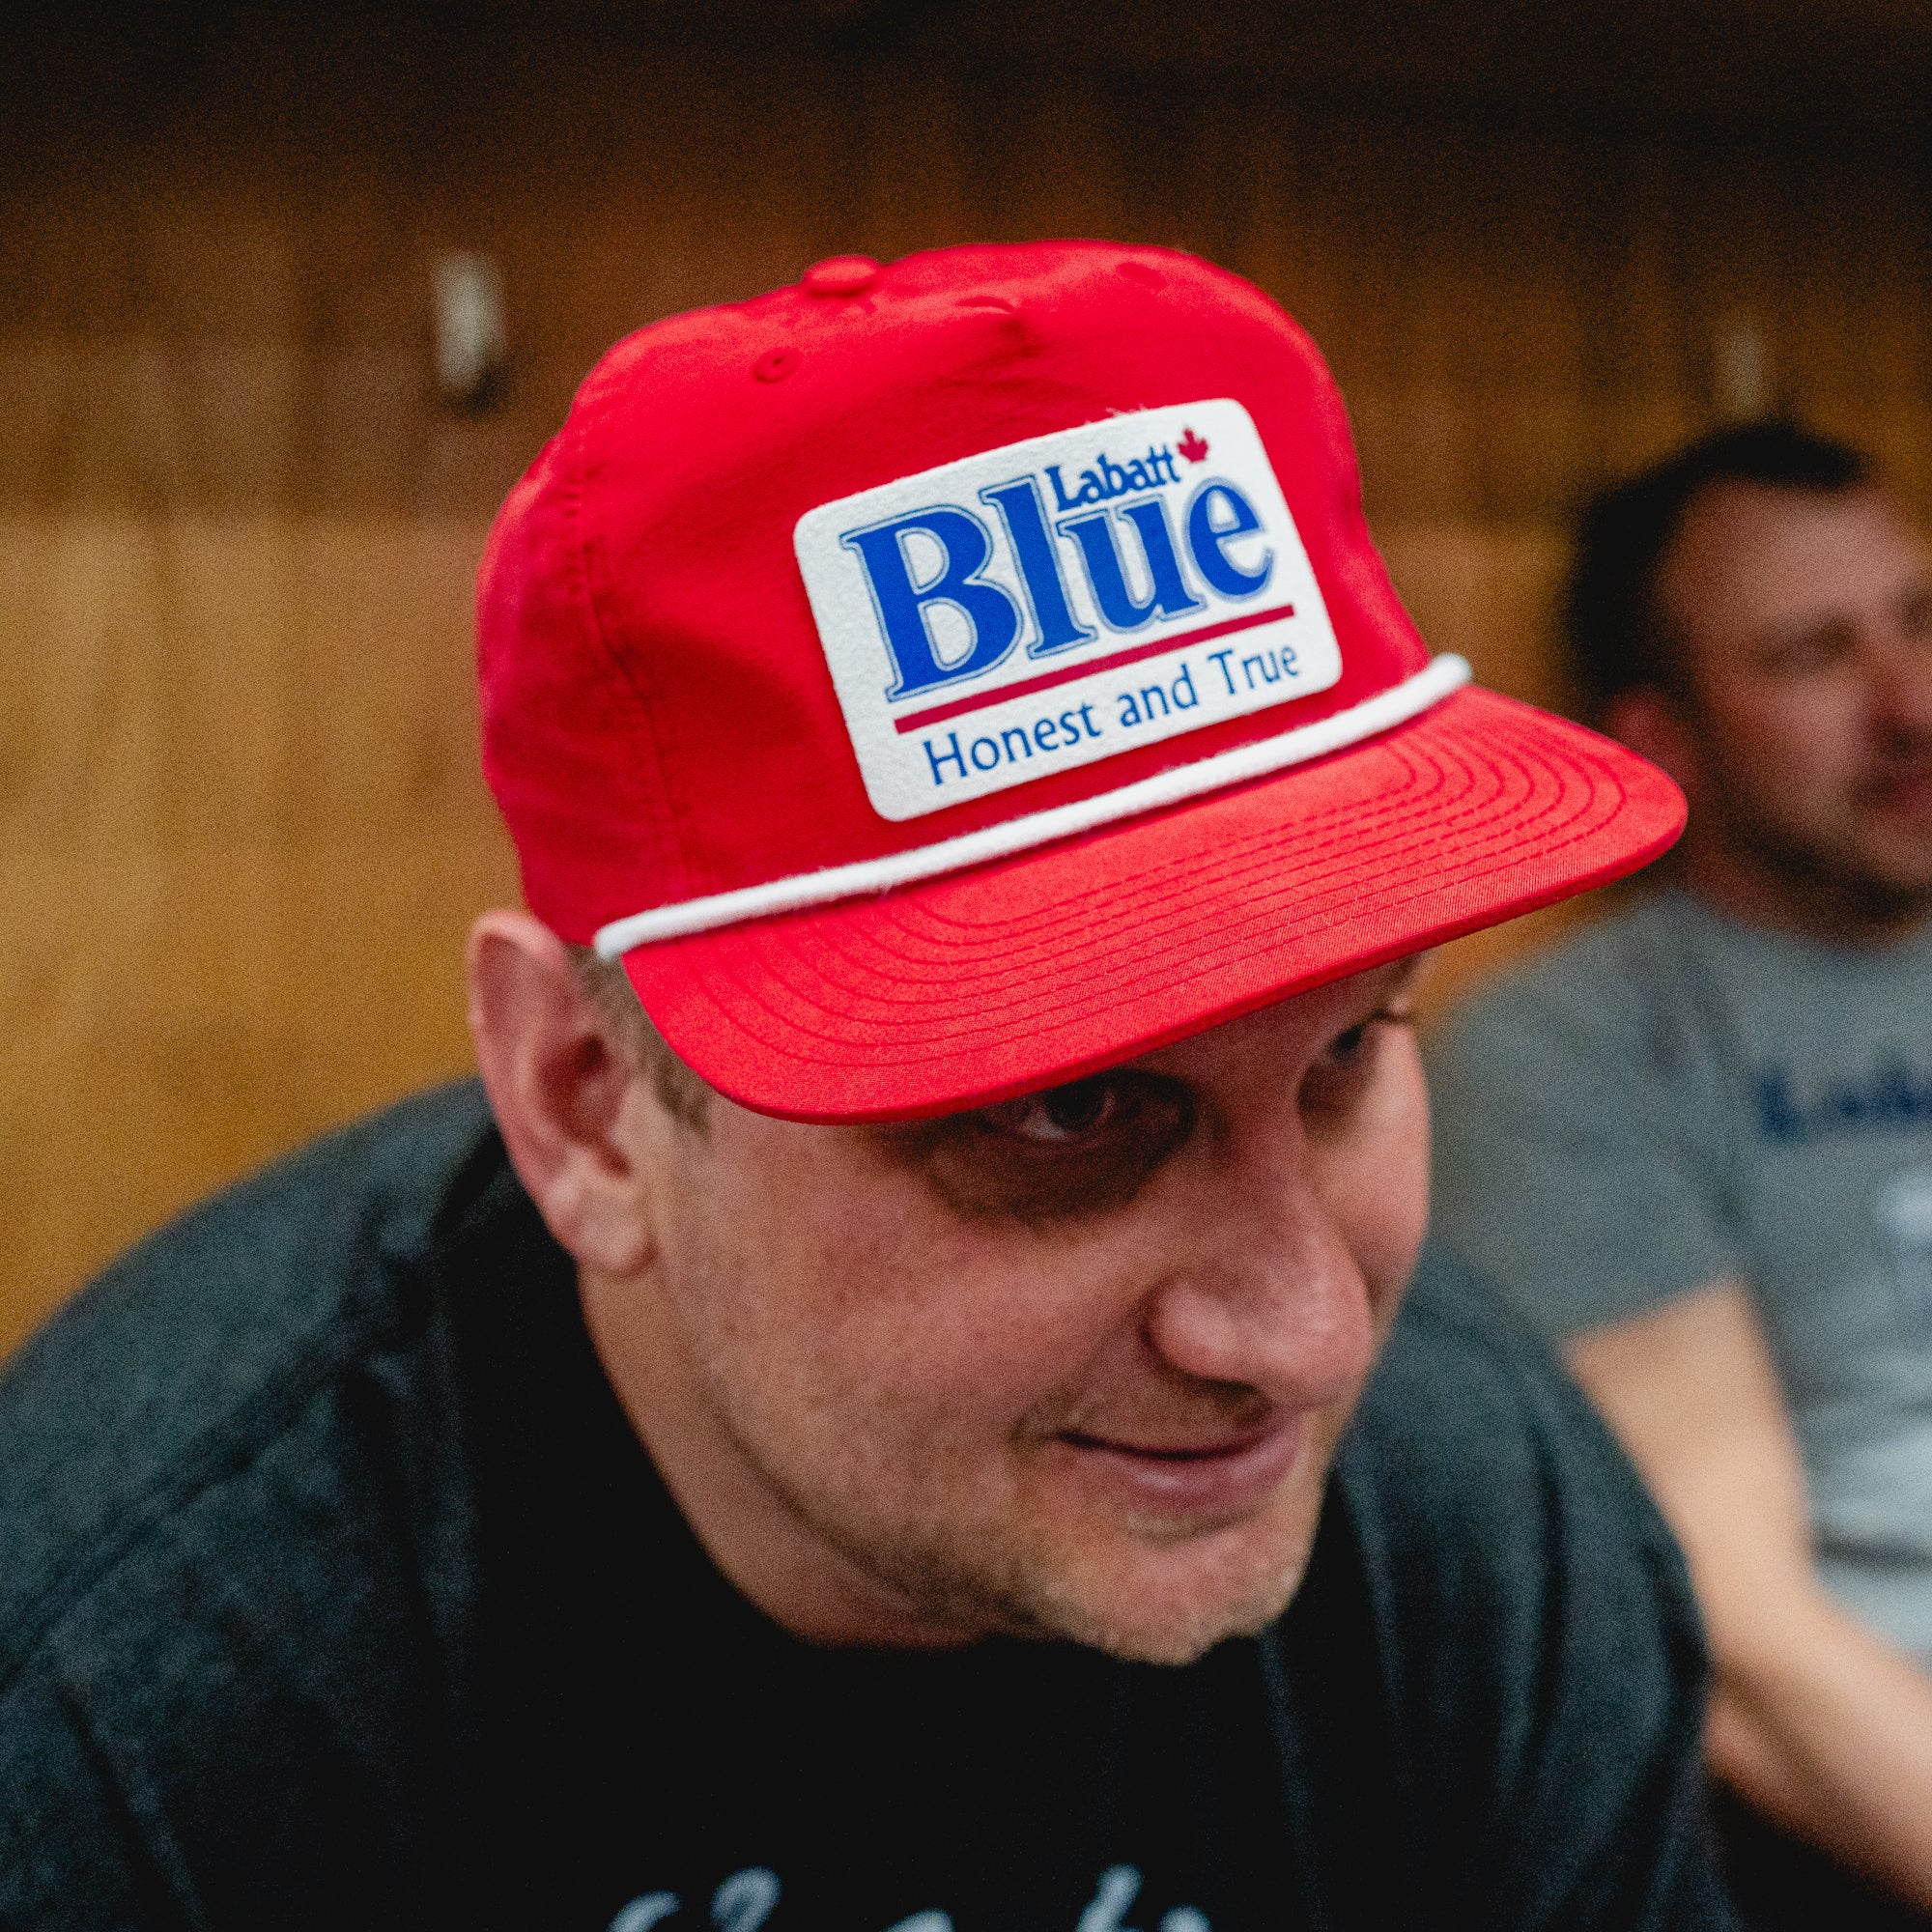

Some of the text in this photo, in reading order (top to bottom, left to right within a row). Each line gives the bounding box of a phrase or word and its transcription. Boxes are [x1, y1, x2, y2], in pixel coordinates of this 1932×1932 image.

[1045, 444, 1180, 510] Labatt
[839, 476, 1275, 701] Blue
[923, 643, 1299, 784] Honest and True
